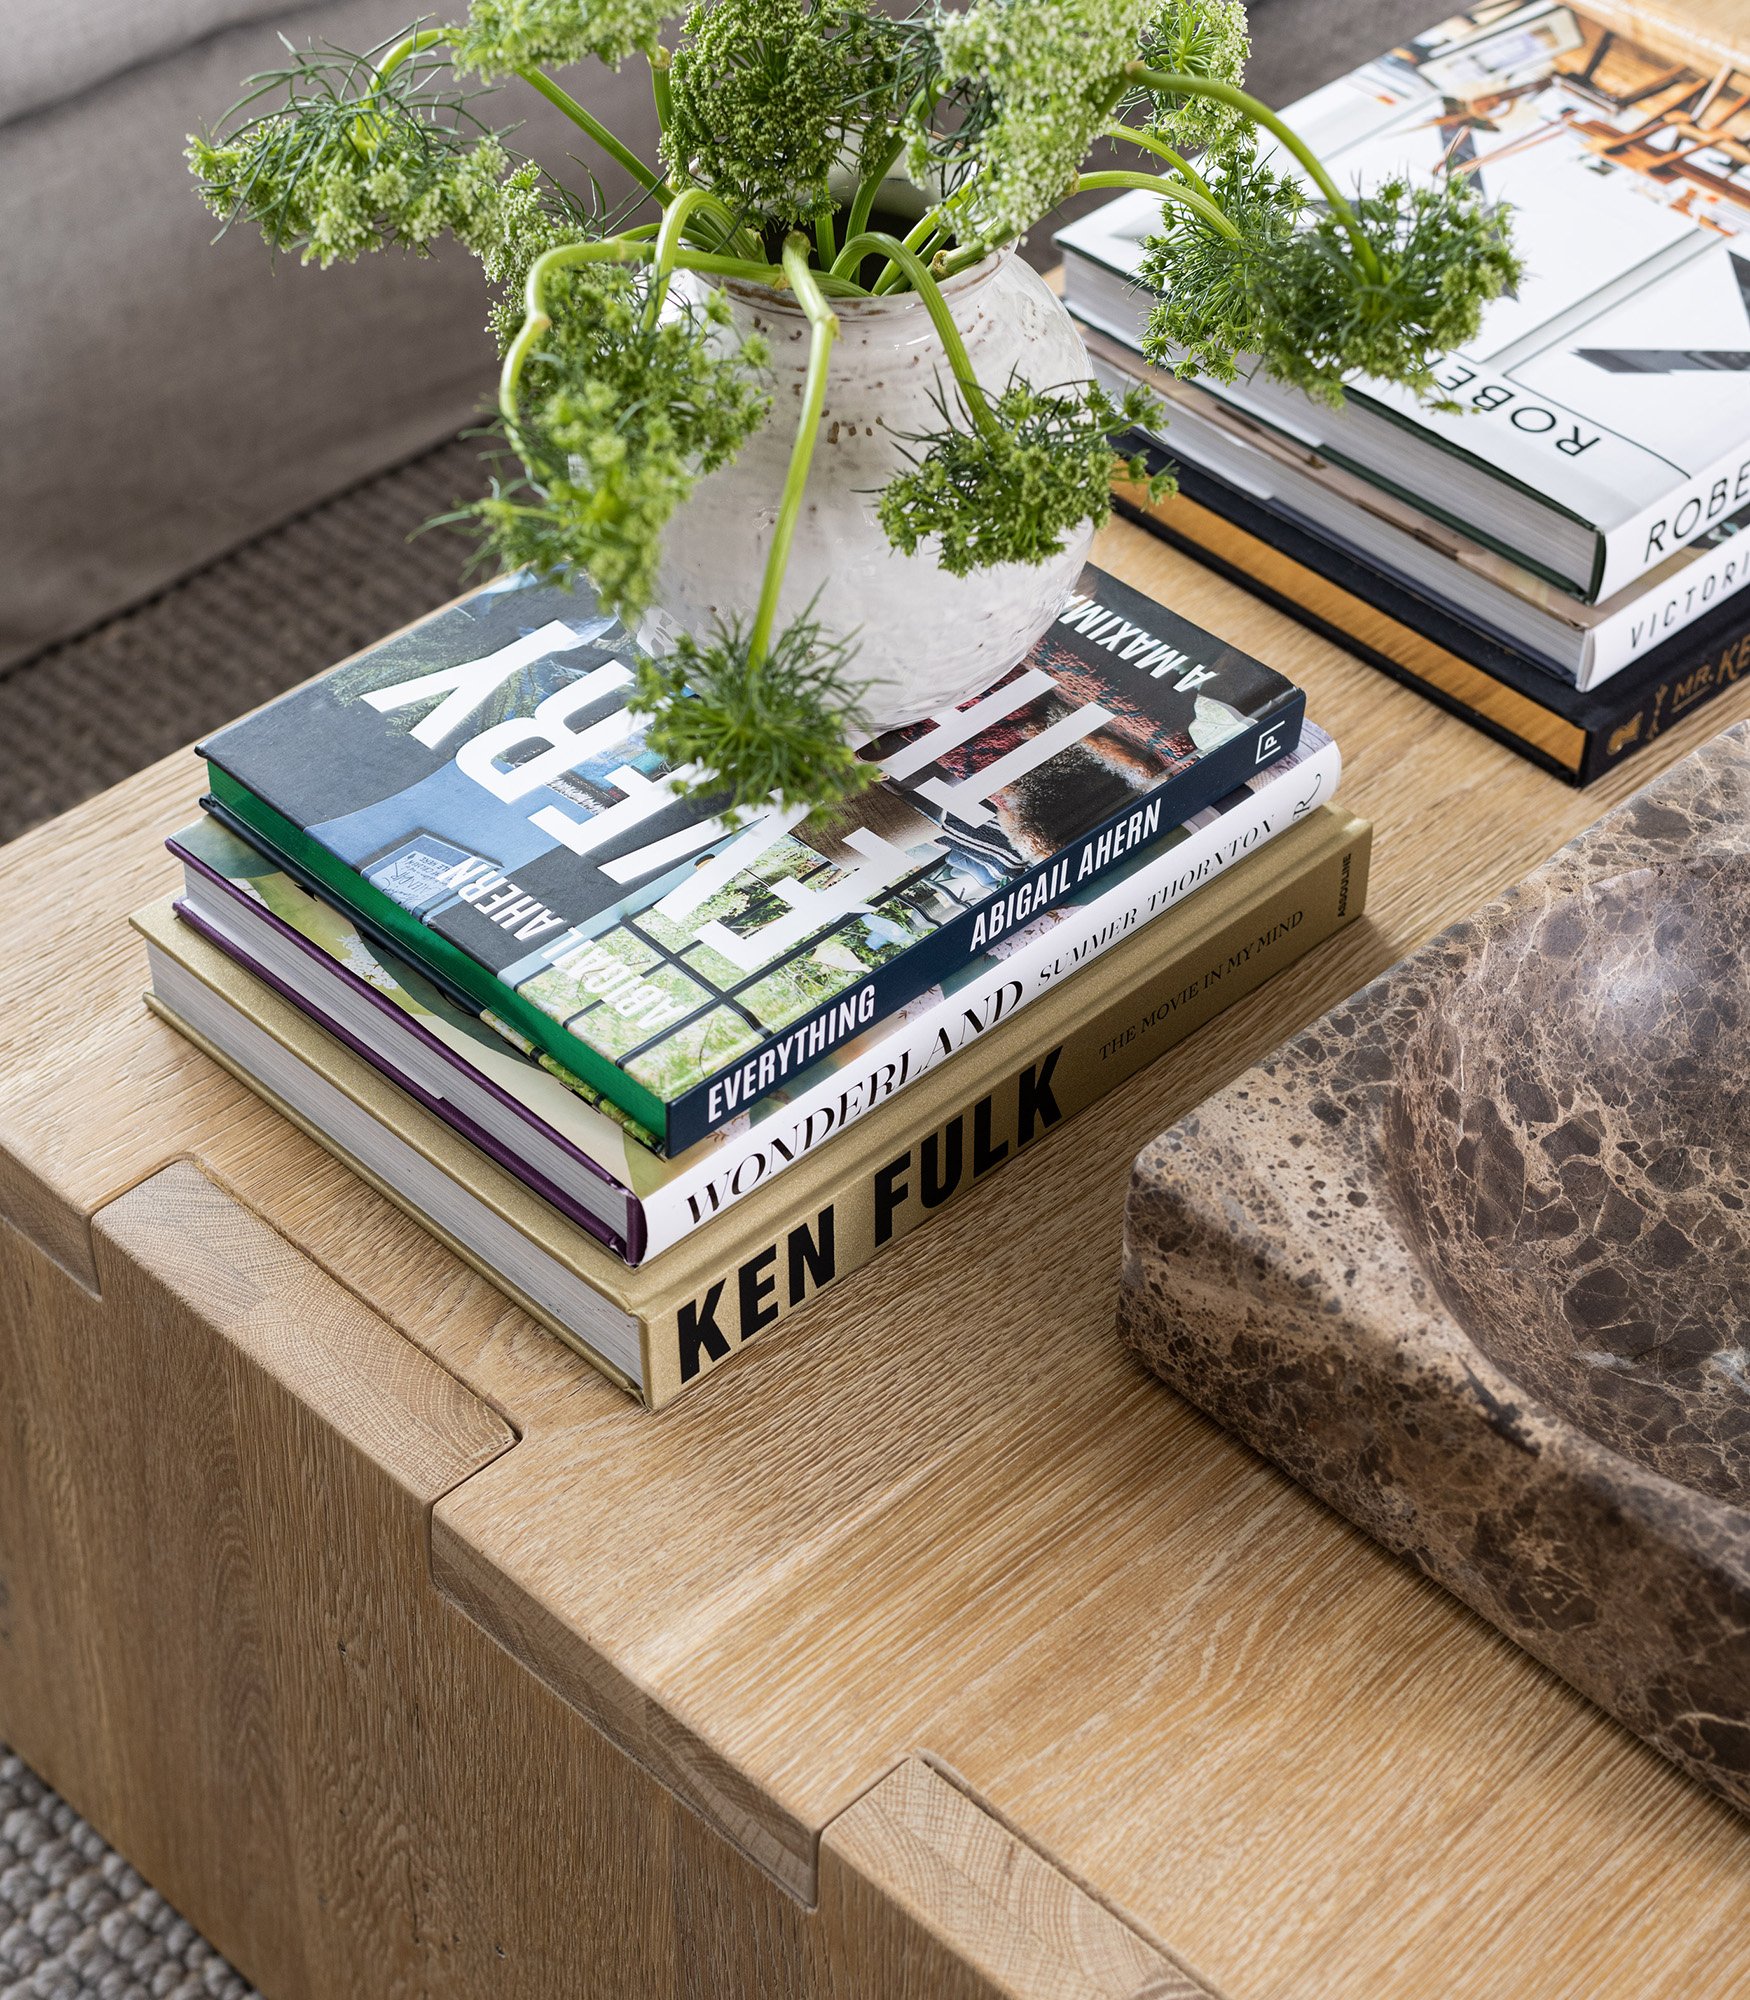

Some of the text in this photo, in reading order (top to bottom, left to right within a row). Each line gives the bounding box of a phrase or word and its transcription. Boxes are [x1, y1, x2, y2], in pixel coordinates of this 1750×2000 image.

[1407, 357, 1600, 457] ROBE
[1172, 663, 1218, 693] A
[436, 856, 568, 943] AHERN
[970, 797, 1163, 952] ABIGAIL AHERN
[1038, 814, 1275, 987] SUMMER THORNTON
[1338, 853, 1351, 917] ASSOULINE
[540, 926, 690, 1031] ABIGAIL
[1099, 911, 1303, 1061] THE MOVIE IN MY MIND
[684, 980, 1023, 1226] WONDERLAND
[708, 984, 876, 1123] EVERYTHING
[676, 1046, 1063, 1385] KEN FULK
